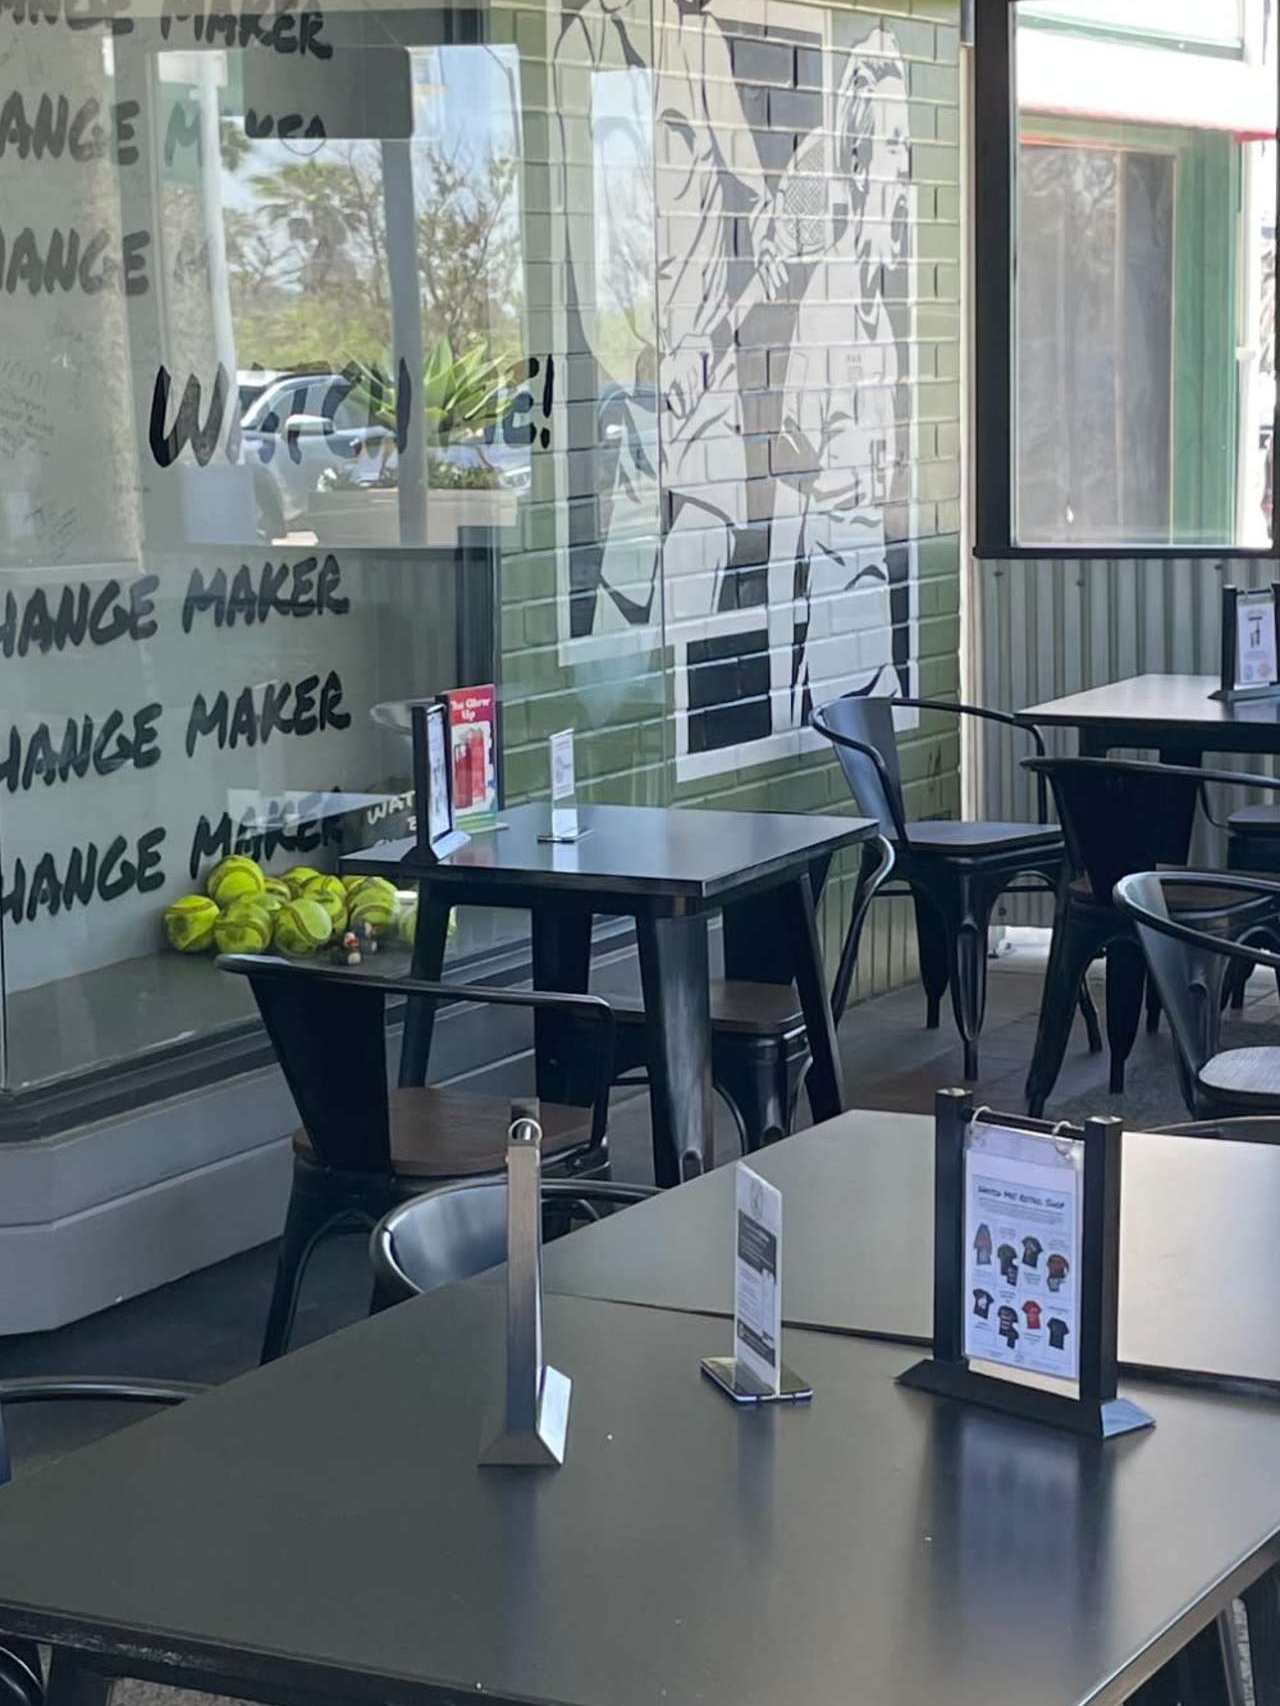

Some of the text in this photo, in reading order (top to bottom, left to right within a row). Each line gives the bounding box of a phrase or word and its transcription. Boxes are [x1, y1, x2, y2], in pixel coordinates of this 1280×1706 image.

[182, 554, 350, 634] MAKER
[186, 670, 352, 758] MAKER
[190, 786, 344, 880] MAKER
